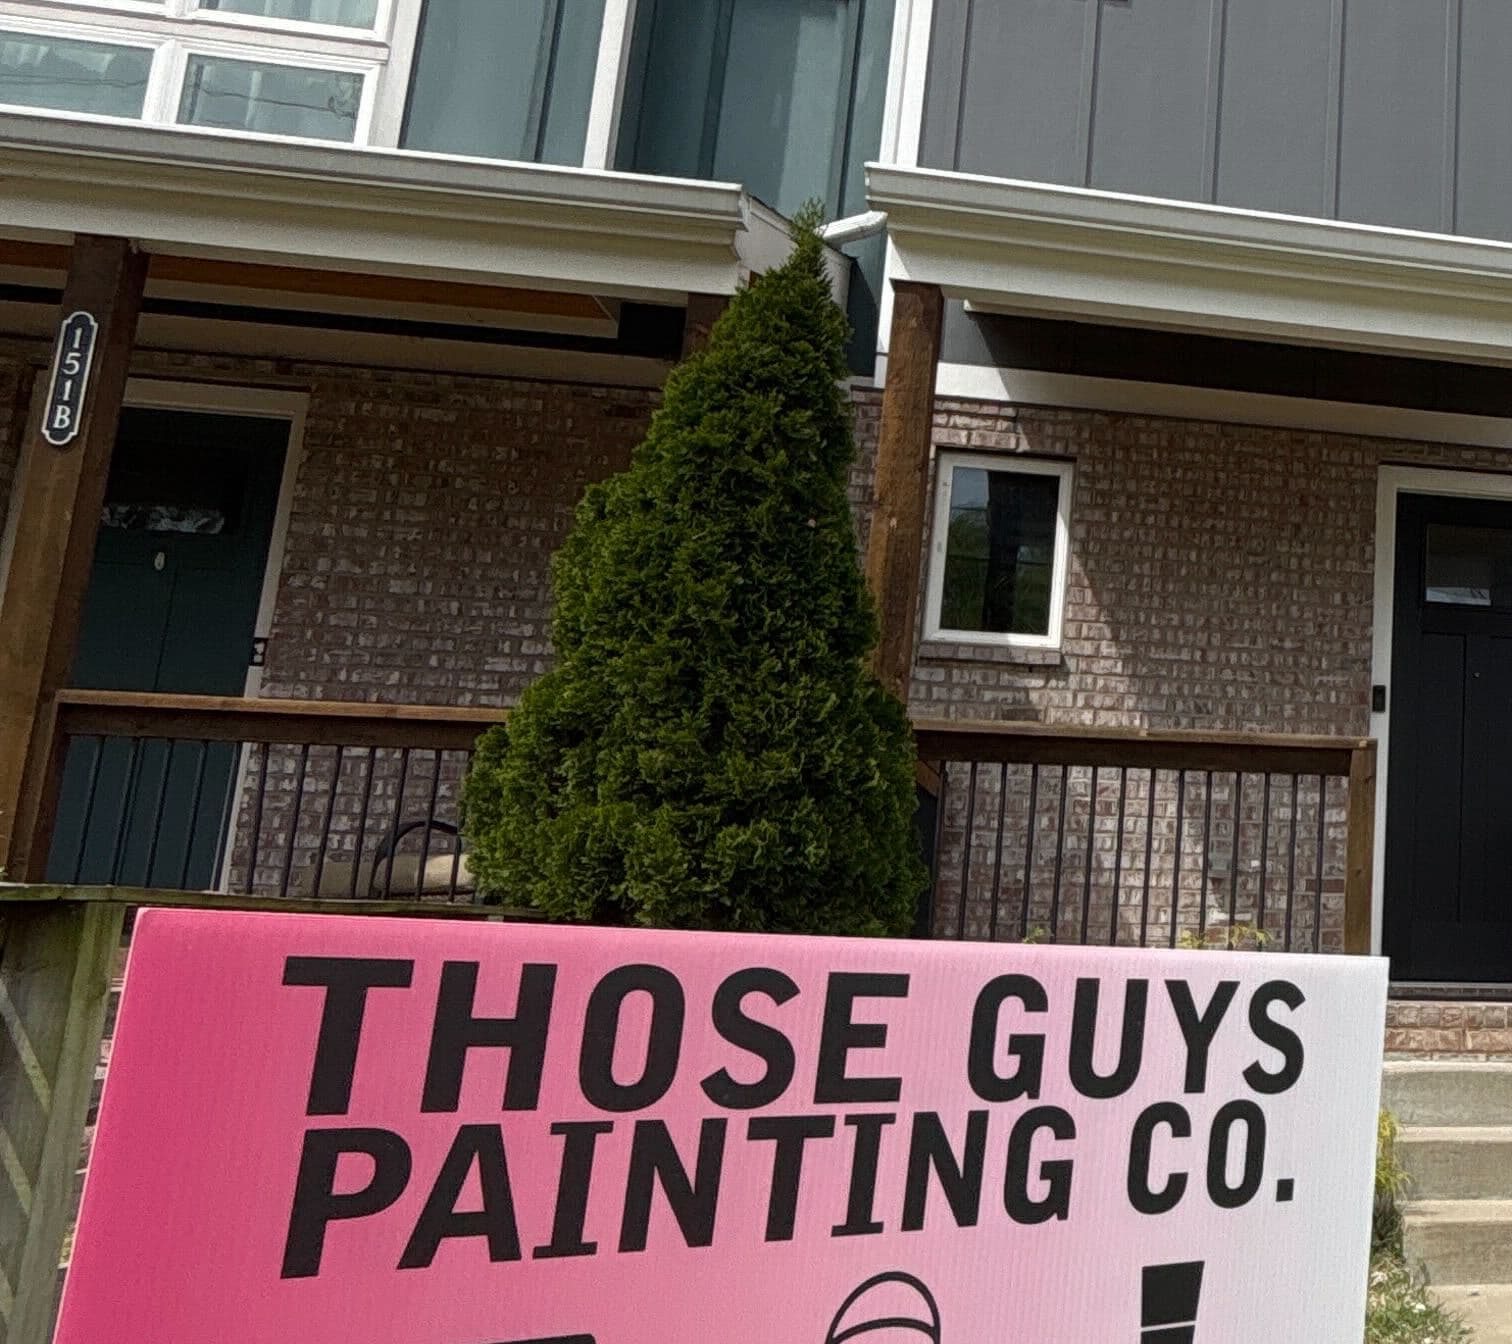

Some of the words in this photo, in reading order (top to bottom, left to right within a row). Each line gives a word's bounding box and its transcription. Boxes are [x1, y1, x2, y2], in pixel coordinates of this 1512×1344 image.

[52, 327, 82, 429] 151B
[281, 955, 910, 1117] THOSE
[967, 973, 1306, 1103] GUYS
[280, 1105, 1076, 1280] PAINTING
[1127, 1099, 1295, 1215] CO.
